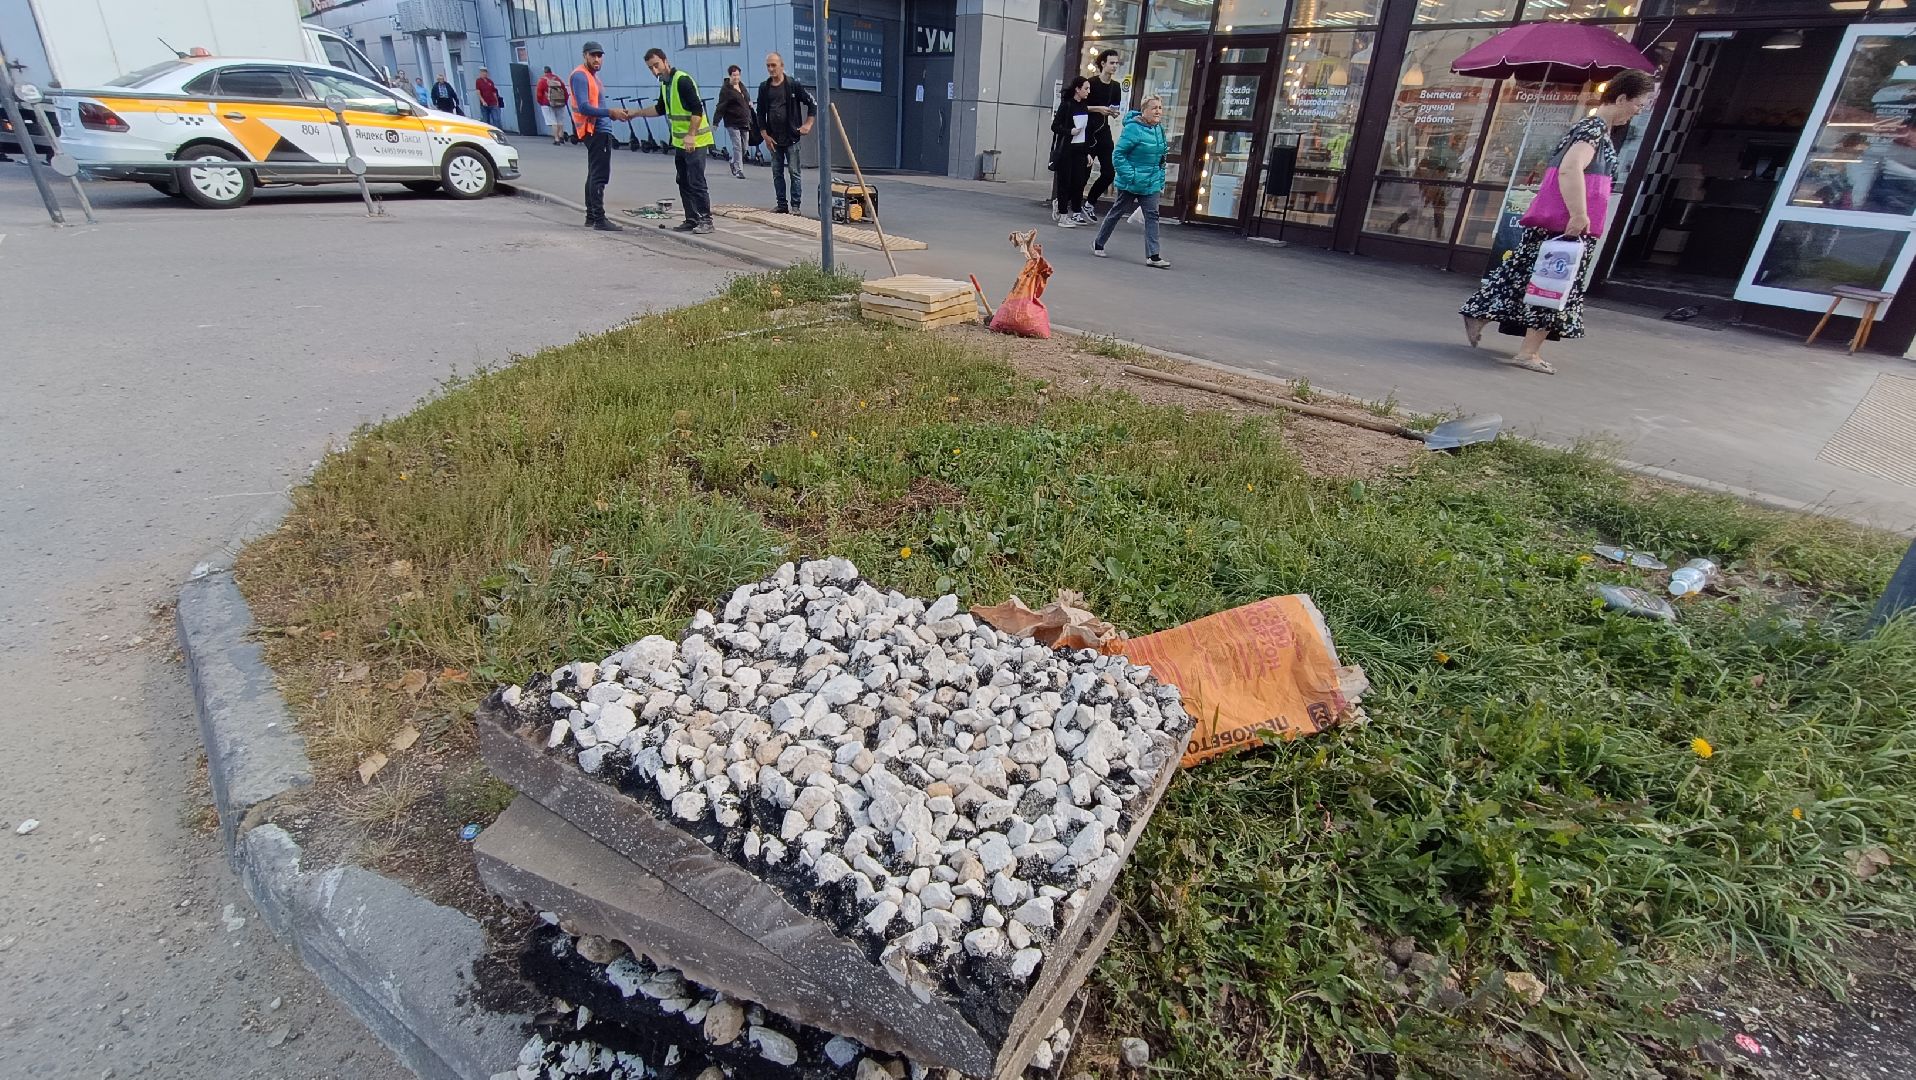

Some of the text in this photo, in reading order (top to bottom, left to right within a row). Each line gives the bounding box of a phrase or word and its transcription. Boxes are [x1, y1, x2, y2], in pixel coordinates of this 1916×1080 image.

[917, 26, 954, 53] УМ
[1225, 85, 1251, 94] Всегда
[1419, 89, 1462, 99] Выпечка
[1222, 97, 1250, 106] свежий
[1515, 91, 1560, 102] Горячий
[1224, 108, 1243, 116] хлеб
[1419, 102, 1455, 113] ручной
[1297, 108, 1337, 119] Хлебницу
[1414, 115, 1455, 124] работы
[301, 124, 320, 136] 804
[355, 128, 421, 144] Яндекс Go Такси
